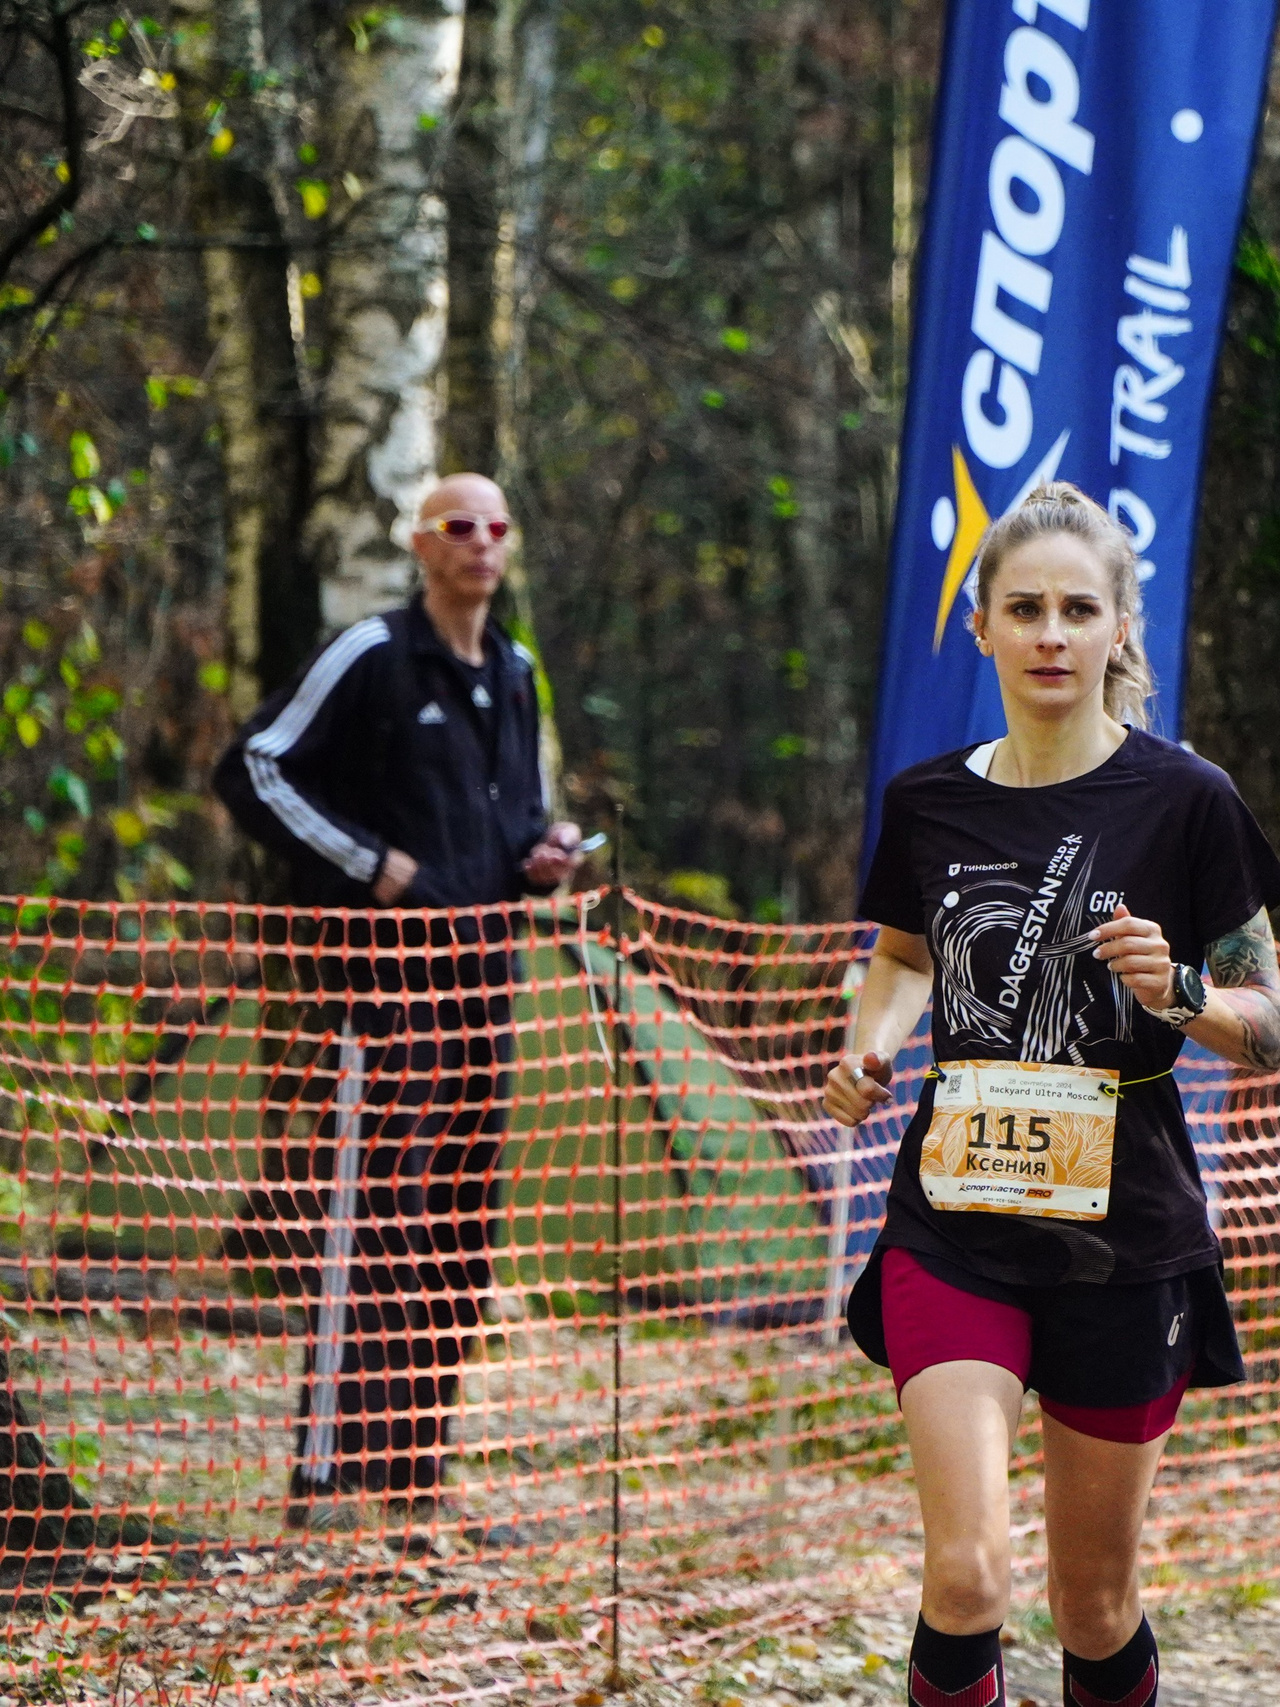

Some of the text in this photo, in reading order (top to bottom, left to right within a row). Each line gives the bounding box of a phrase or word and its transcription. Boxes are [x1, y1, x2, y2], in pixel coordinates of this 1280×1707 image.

[1110, 224, 1193, 466] TRAIL
[962, 862, 1018, 872] ТИНЬКОФФ
[1055, 845, 1080, 877] TRAIL
[999, 845, 1067, 1010] DAGESTAN WILD
[989, 1085, 1099, 1102] Backyard Ultra Moscow
[967, 1112, 1051, 1153] 115
[966, 1153, 1046, 1176] Ксения
[1026, 1188, 1053, 1198] PRO
